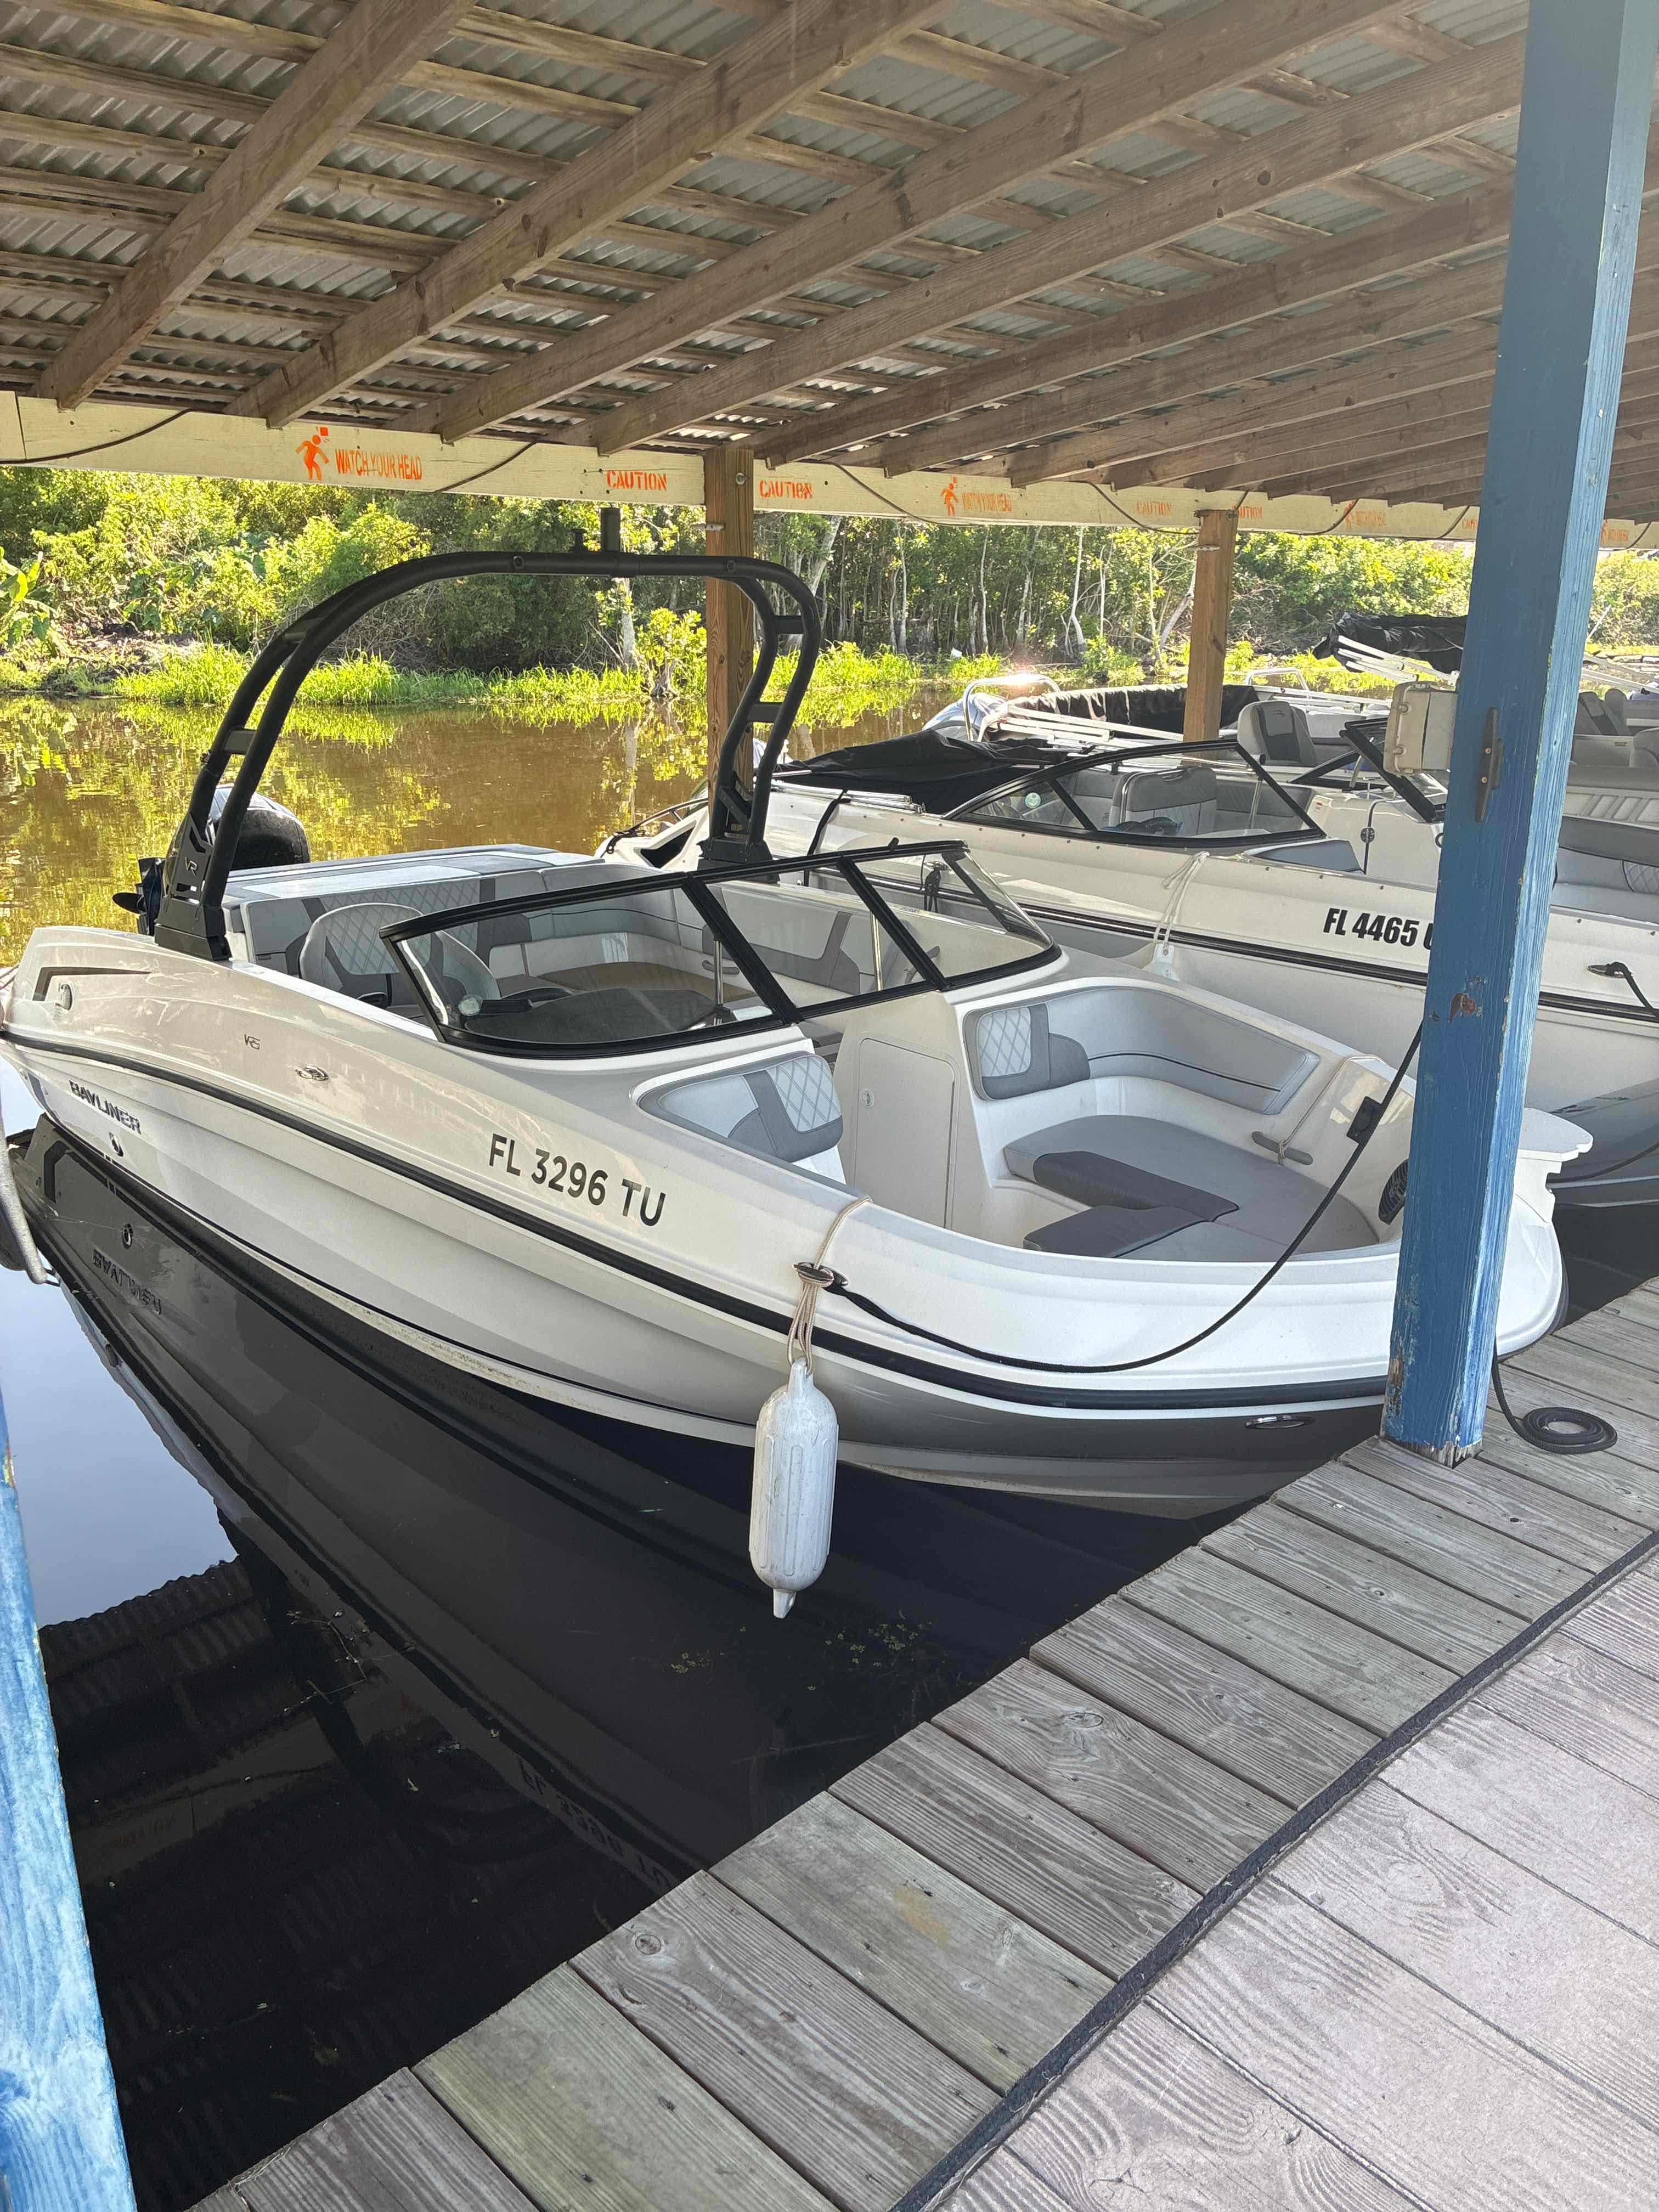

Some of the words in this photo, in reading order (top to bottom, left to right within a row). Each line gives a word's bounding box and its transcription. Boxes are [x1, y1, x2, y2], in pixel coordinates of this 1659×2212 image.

[335, 448, 369, 476] WATCH
[370, 452, 397, 478] YOUR
[397, 454, 422, 480] HEAD
[606, 470, 668, 491] CAUTION
[759, 480, 813, 499] CAUTION
[184, 856, 198, 878] VR
[1323, 907, 1348, 936] FL
[1351, 912, 1420, 947] 4465
[69, 1079, 142, 1135] BAYLINER
[488, 1133, 521, 1177] FL
[531, 1148, 608, 1206] 3296
[621, 1178, 667, 1227] TU
